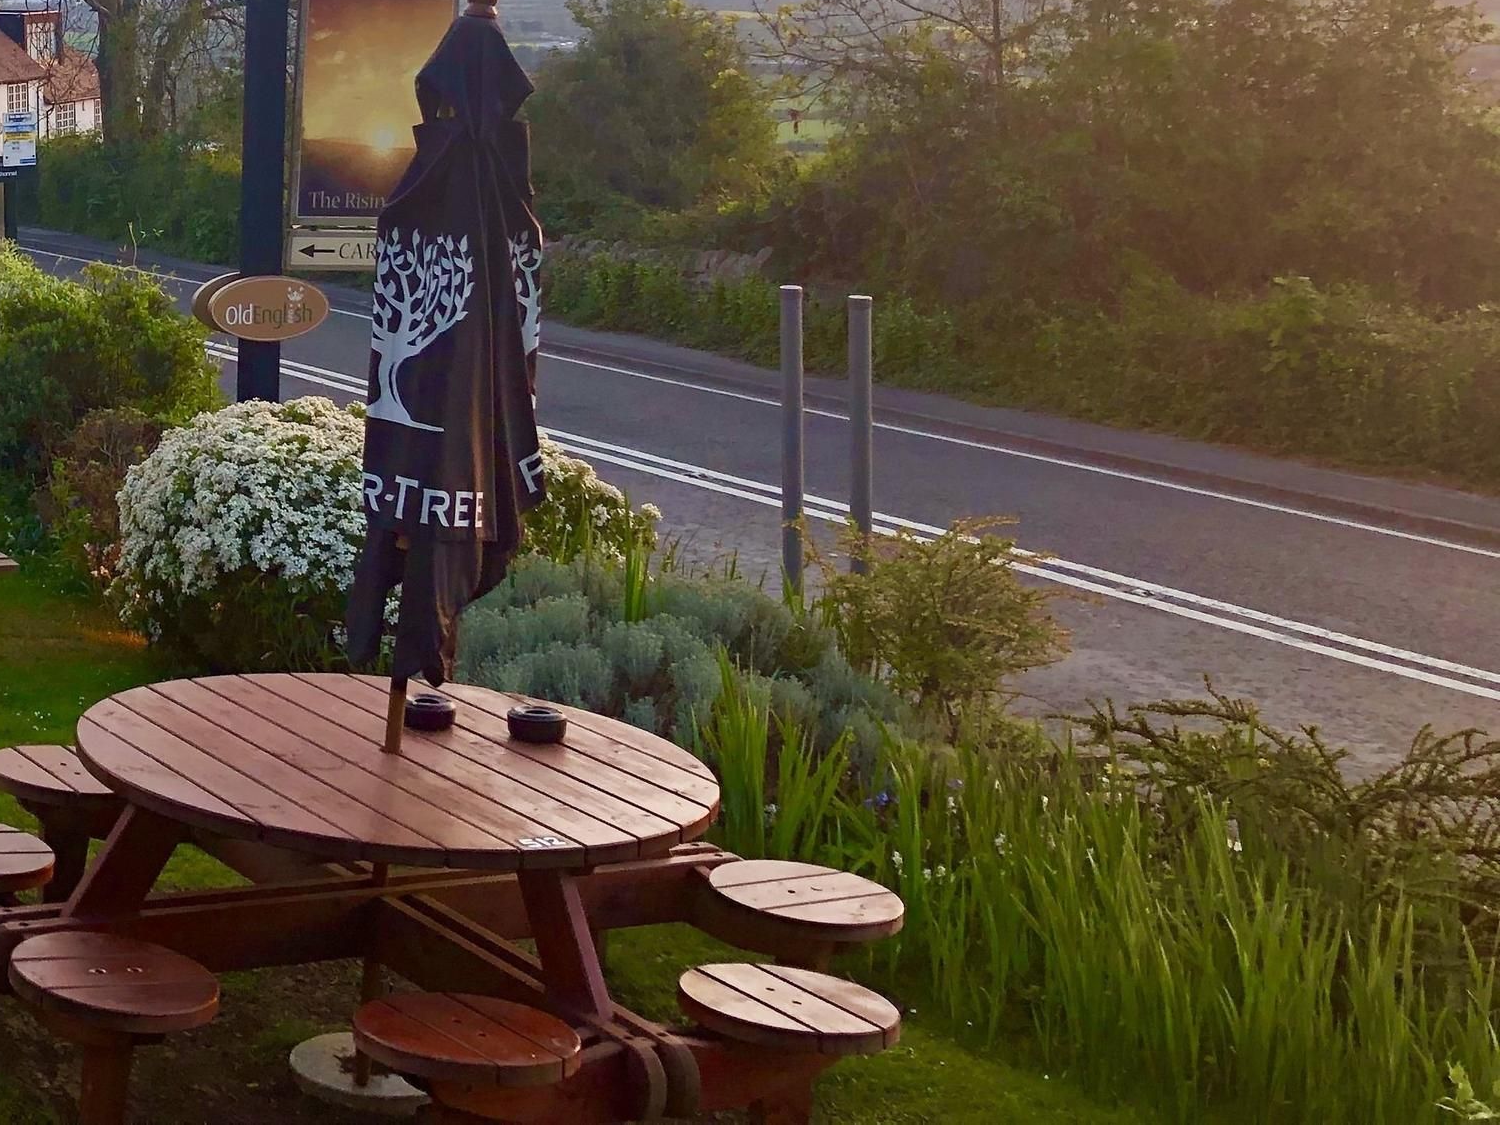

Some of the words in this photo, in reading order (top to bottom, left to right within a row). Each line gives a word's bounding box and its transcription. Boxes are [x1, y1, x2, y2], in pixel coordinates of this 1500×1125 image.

[308, 190, 340, 209] The
[345, 191, 386, 209] Risin
[339, 242, 377, 260] CAR
[518, 836, 567, 848] 512
